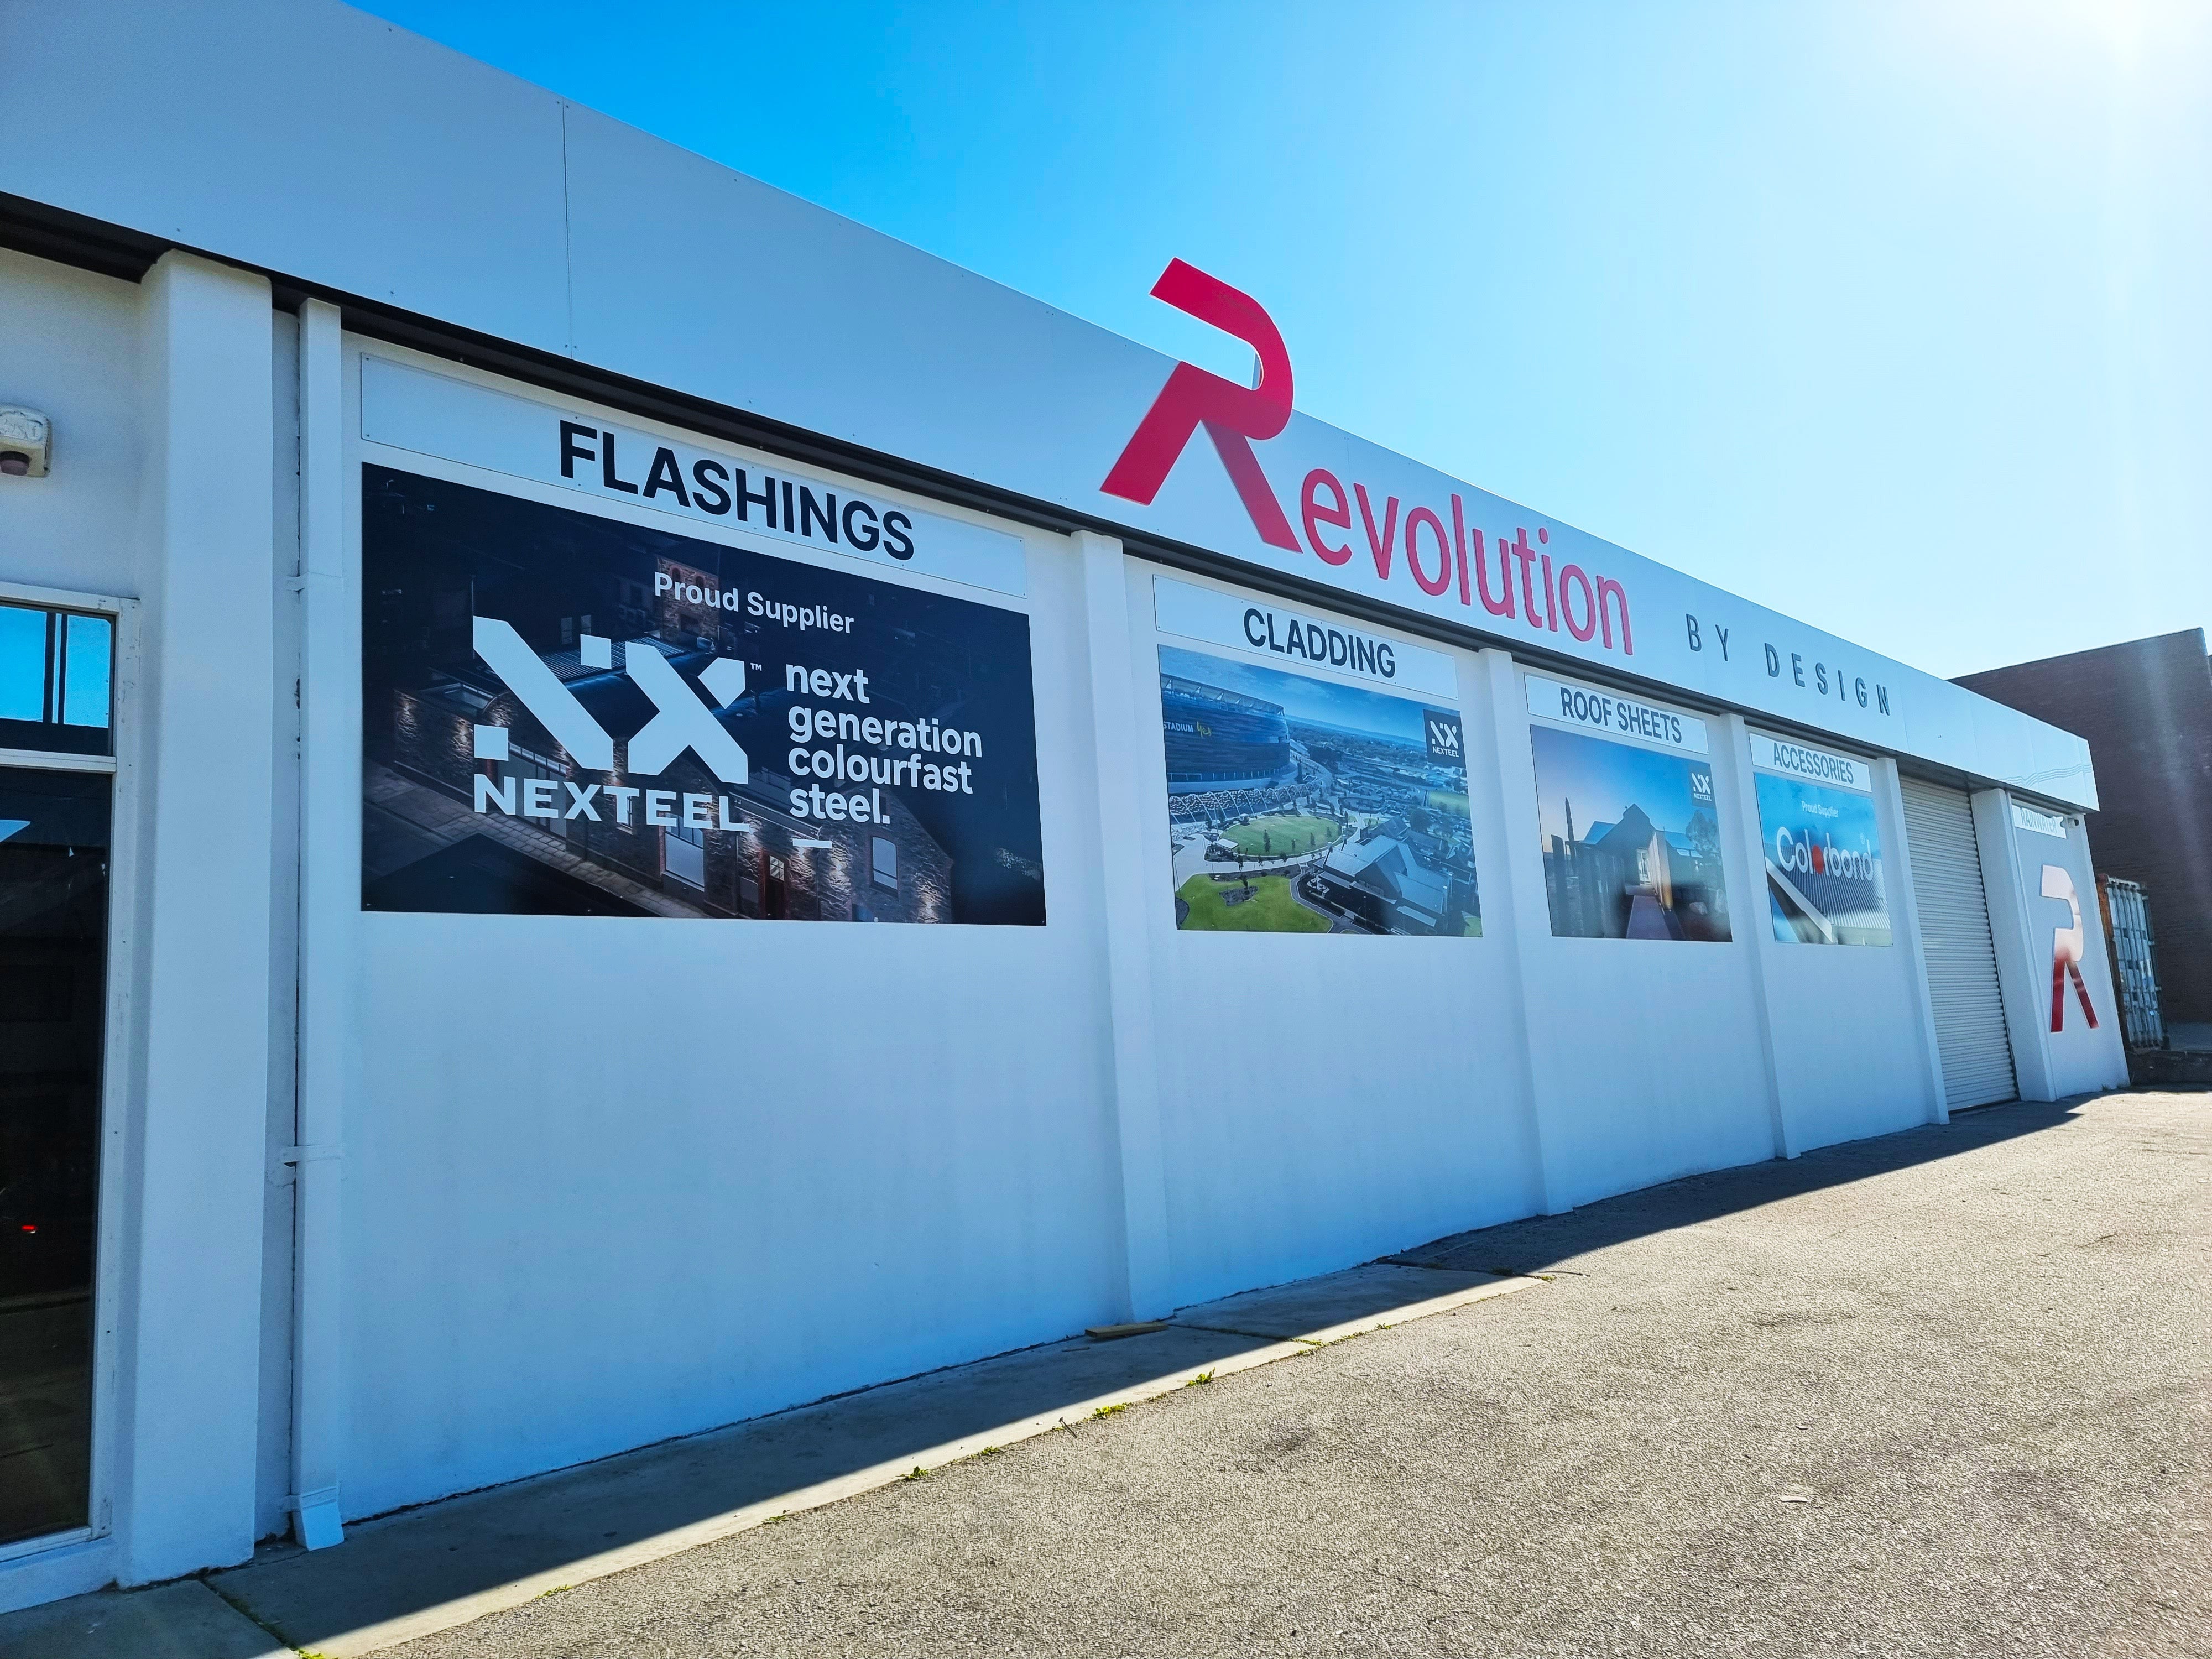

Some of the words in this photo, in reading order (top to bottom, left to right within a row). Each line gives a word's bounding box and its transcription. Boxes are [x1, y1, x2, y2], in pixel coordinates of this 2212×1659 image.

[559, 419, 914, 562] FLASHINGS
[1100, 257, 1633, 656] Revolution
[1686, 613, 1731, 662] BY
[1765, 642, 1891, 717] DESIGN
[654, 571, 739, 613] Proud
[747, 591, 854, 635] Supplier
[1244, 608, 1396, 679] CLADDING
[786, 664, 870, 705] next
[788, 703, 982, 758] generation
[1163, 721, 1194, 733] STADIUM
[1560, 687, 1612, 727] ROOF
[1617, 702, 1683, 744] SHEETS
[787, 743, 973, 795] colourfast
[1432, 746, 1460, 758] NEXTEEL
[1773, 742, 1855, 785] ACCESSORIES
[474, 774, 752, 833] NEXTEEL
[789, 784, 891, 825] steel.
[1802, 801, 1818, 813] Proud
